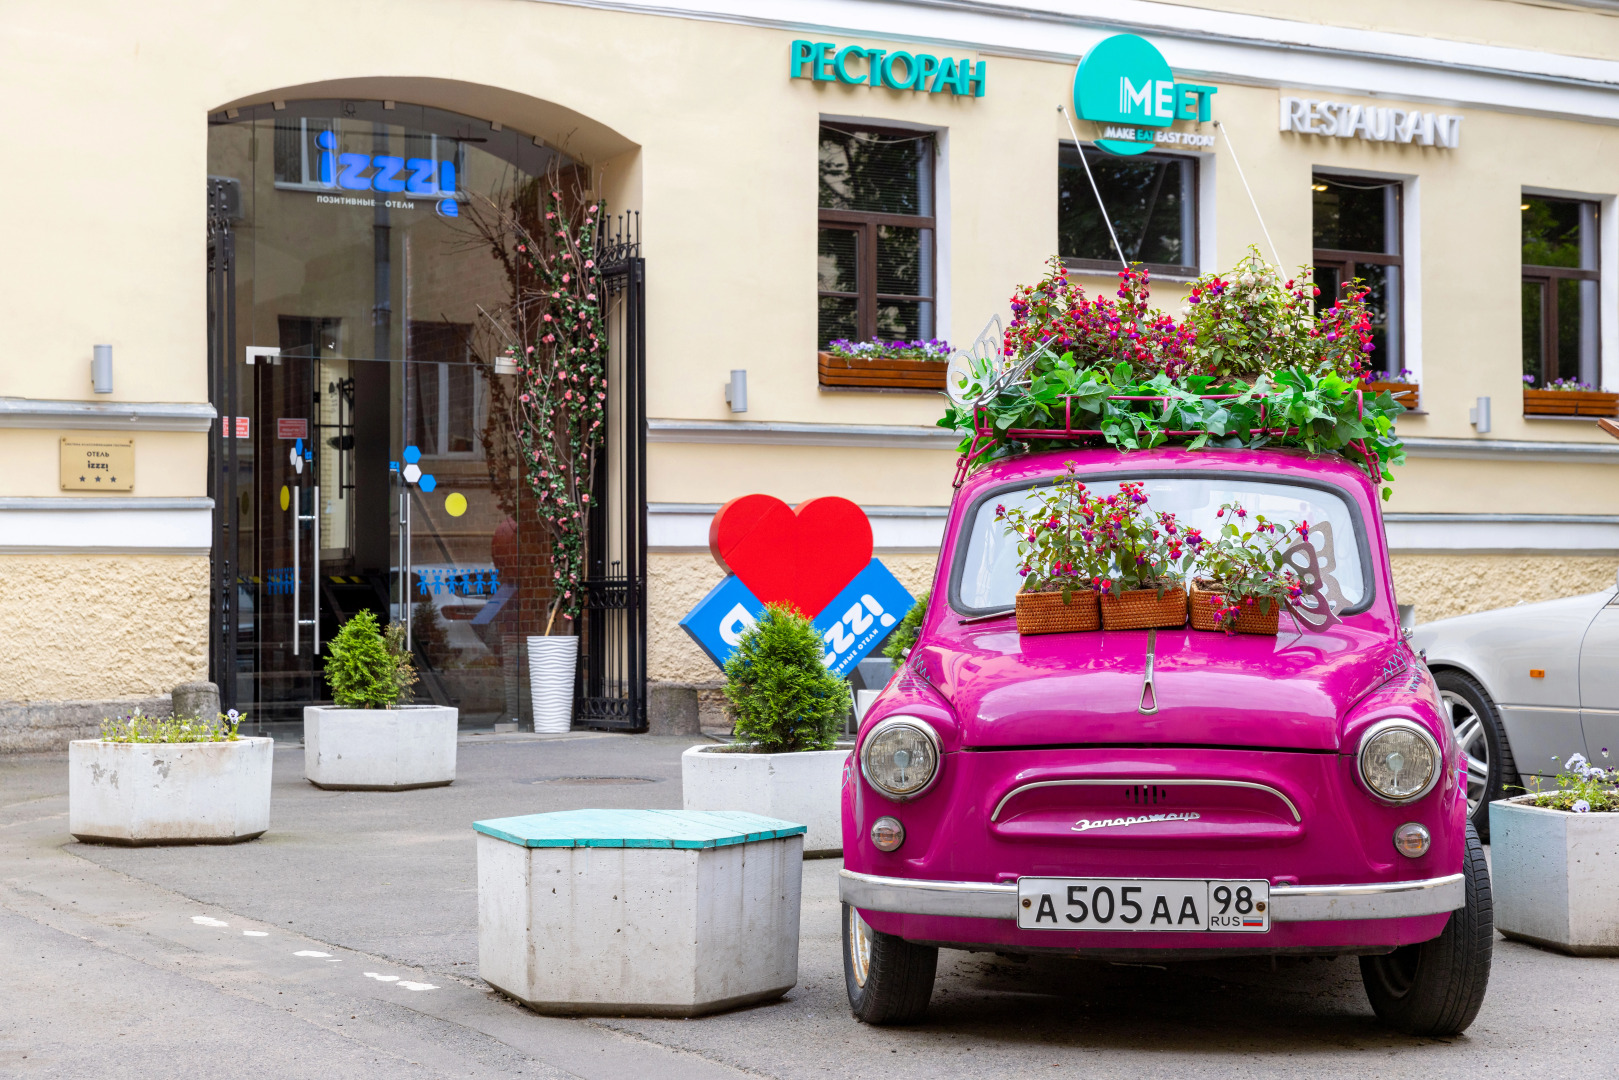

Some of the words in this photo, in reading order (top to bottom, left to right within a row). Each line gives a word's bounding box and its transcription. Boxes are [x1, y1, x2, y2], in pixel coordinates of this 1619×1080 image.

[789, 40, 987, 98] РЕСТОРАН
[1119, 76, 1218, 123] MEET
[1105, 126, 1135, 139] MAKE
[1136, 129, 1154, 141] EAT
[1155, 131, 1181, 144] EASY
[1181, 133, 1216, 147] TODAY
[1279, 97, 1465, 149] RESTAURANT
[316, 195, 376, 207] ПОЗИТИВНЫЕ
[385, 200, 414, 210] ОТЕЛИ
[1213, 885, 1254, 915] 98
[1210, 916, 1241, 927] RUS
